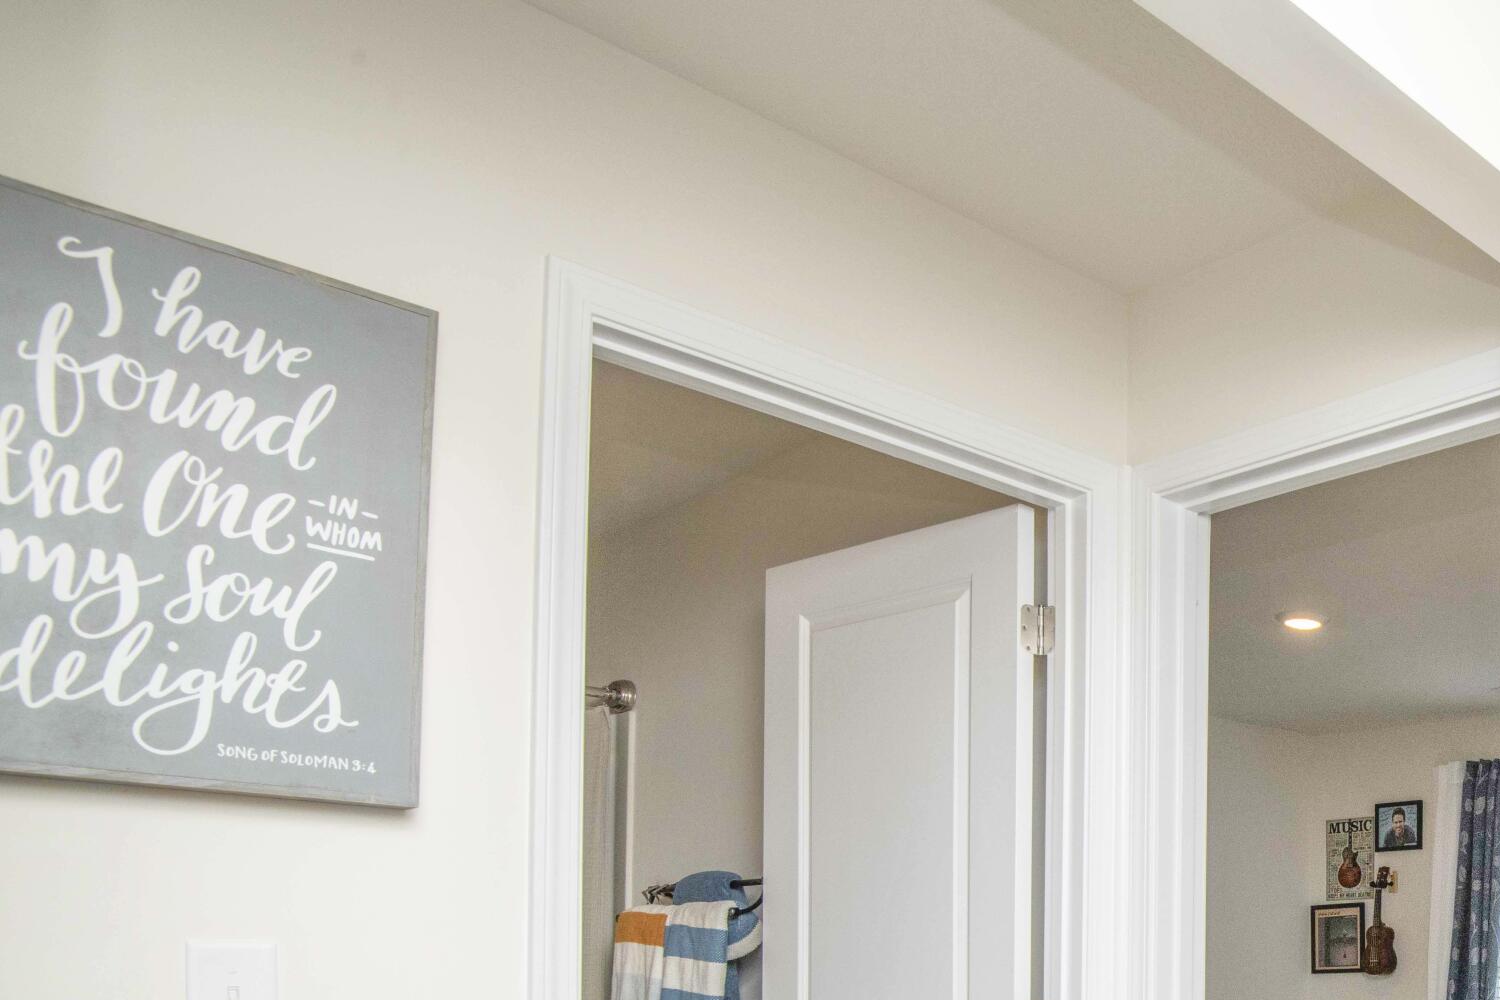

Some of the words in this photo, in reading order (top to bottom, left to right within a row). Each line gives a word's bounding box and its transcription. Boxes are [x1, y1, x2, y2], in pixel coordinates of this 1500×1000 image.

[58, 236, 122, 338] I
[152, 266, 312, 379] have
[18, 302, 337, 471] found
[0, 403, 124, 518] the
[143, 449, 297, 555] One
[305, 515, 383, 552] WHOM
[0, 527, 165, 640] my
[0, 614, 360, 756] delights
[216, 743, 258, 762] SONG
[260, 749, 279, 763] OF
[280, 750, 349, 771] SOLOMAN
[351, 759, 377, 774] 3:4
[1328, 819, 1372, 835] MUSIC
